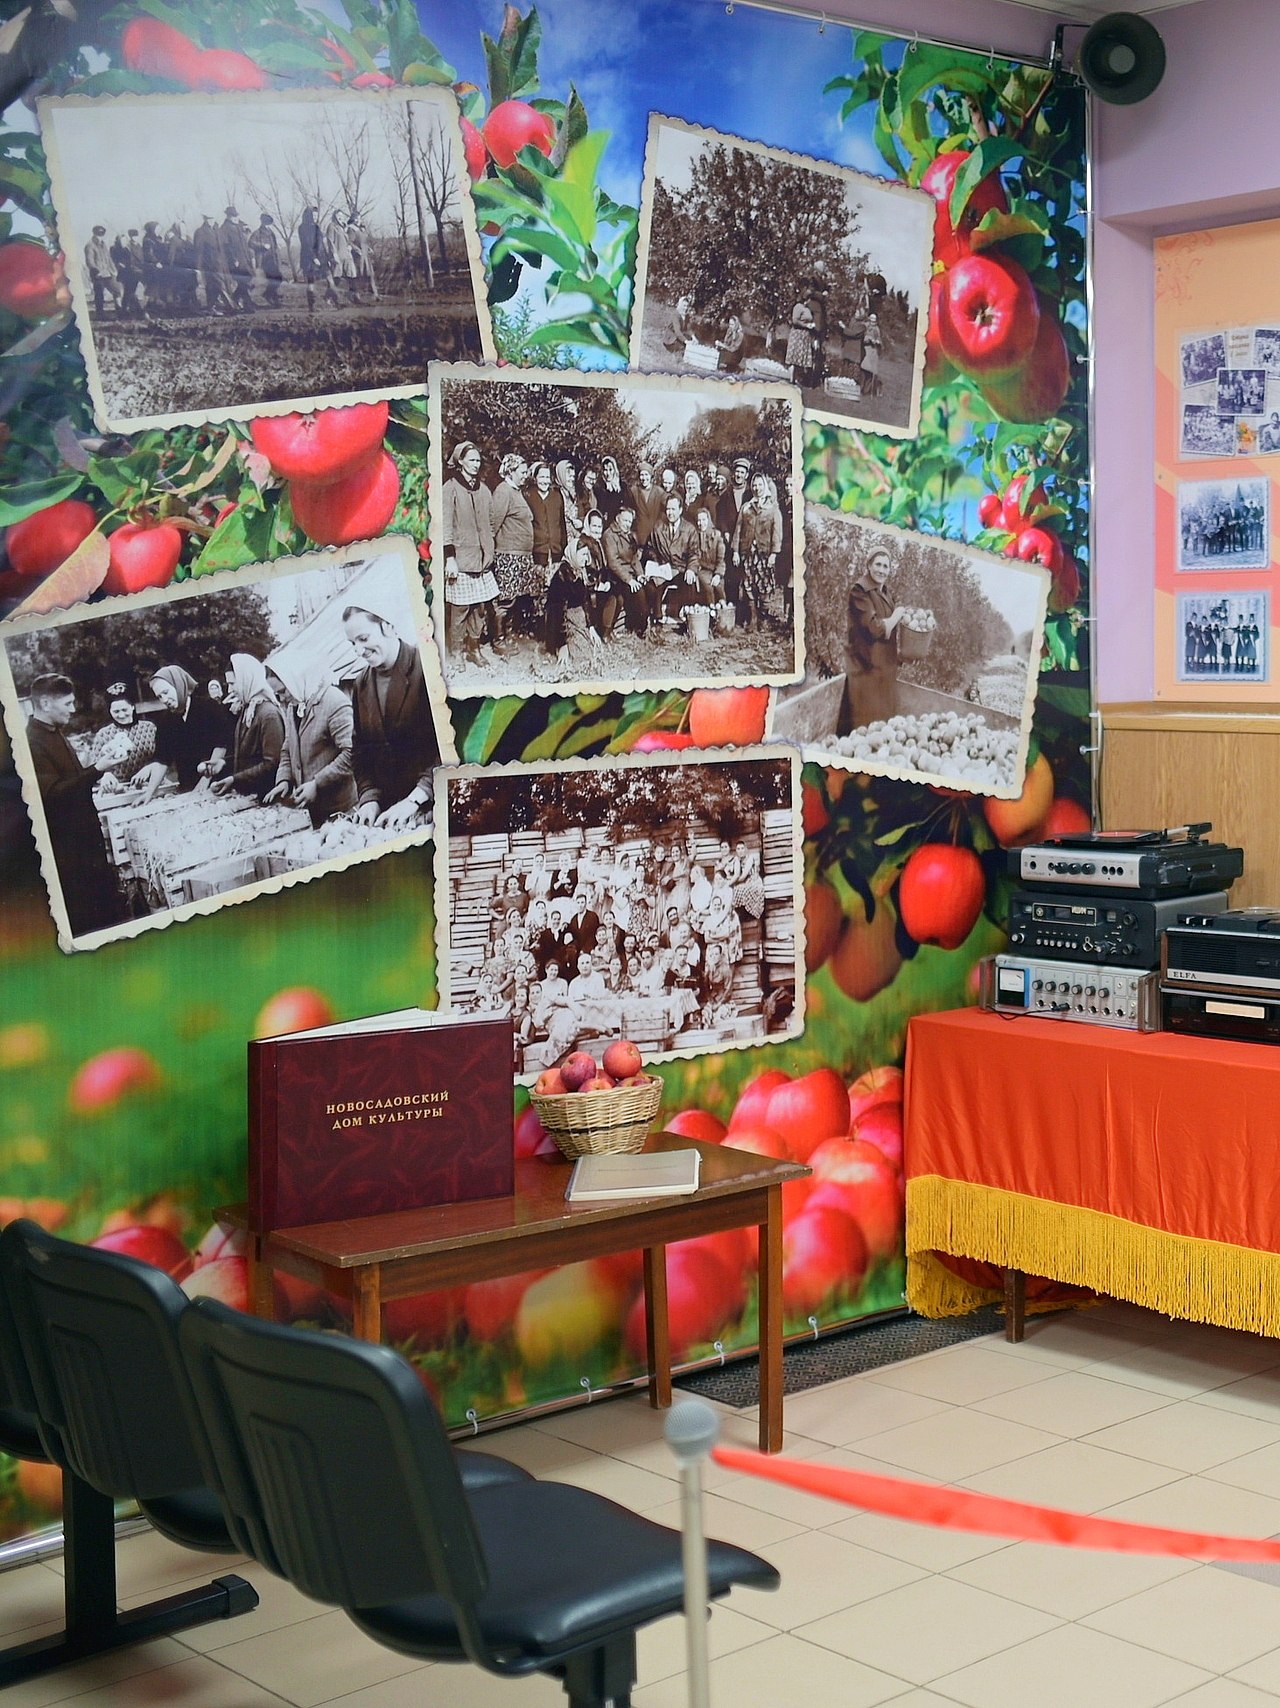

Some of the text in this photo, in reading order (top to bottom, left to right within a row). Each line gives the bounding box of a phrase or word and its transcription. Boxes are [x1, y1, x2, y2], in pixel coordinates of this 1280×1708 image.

[1173, 970, 1197, 980] ELFA
[326, 1090, 449, 1114] НОВОСАДОВСКИЙ
[332, 1107, 443, 1130] ДОМ КУЛЬТУРЫ
